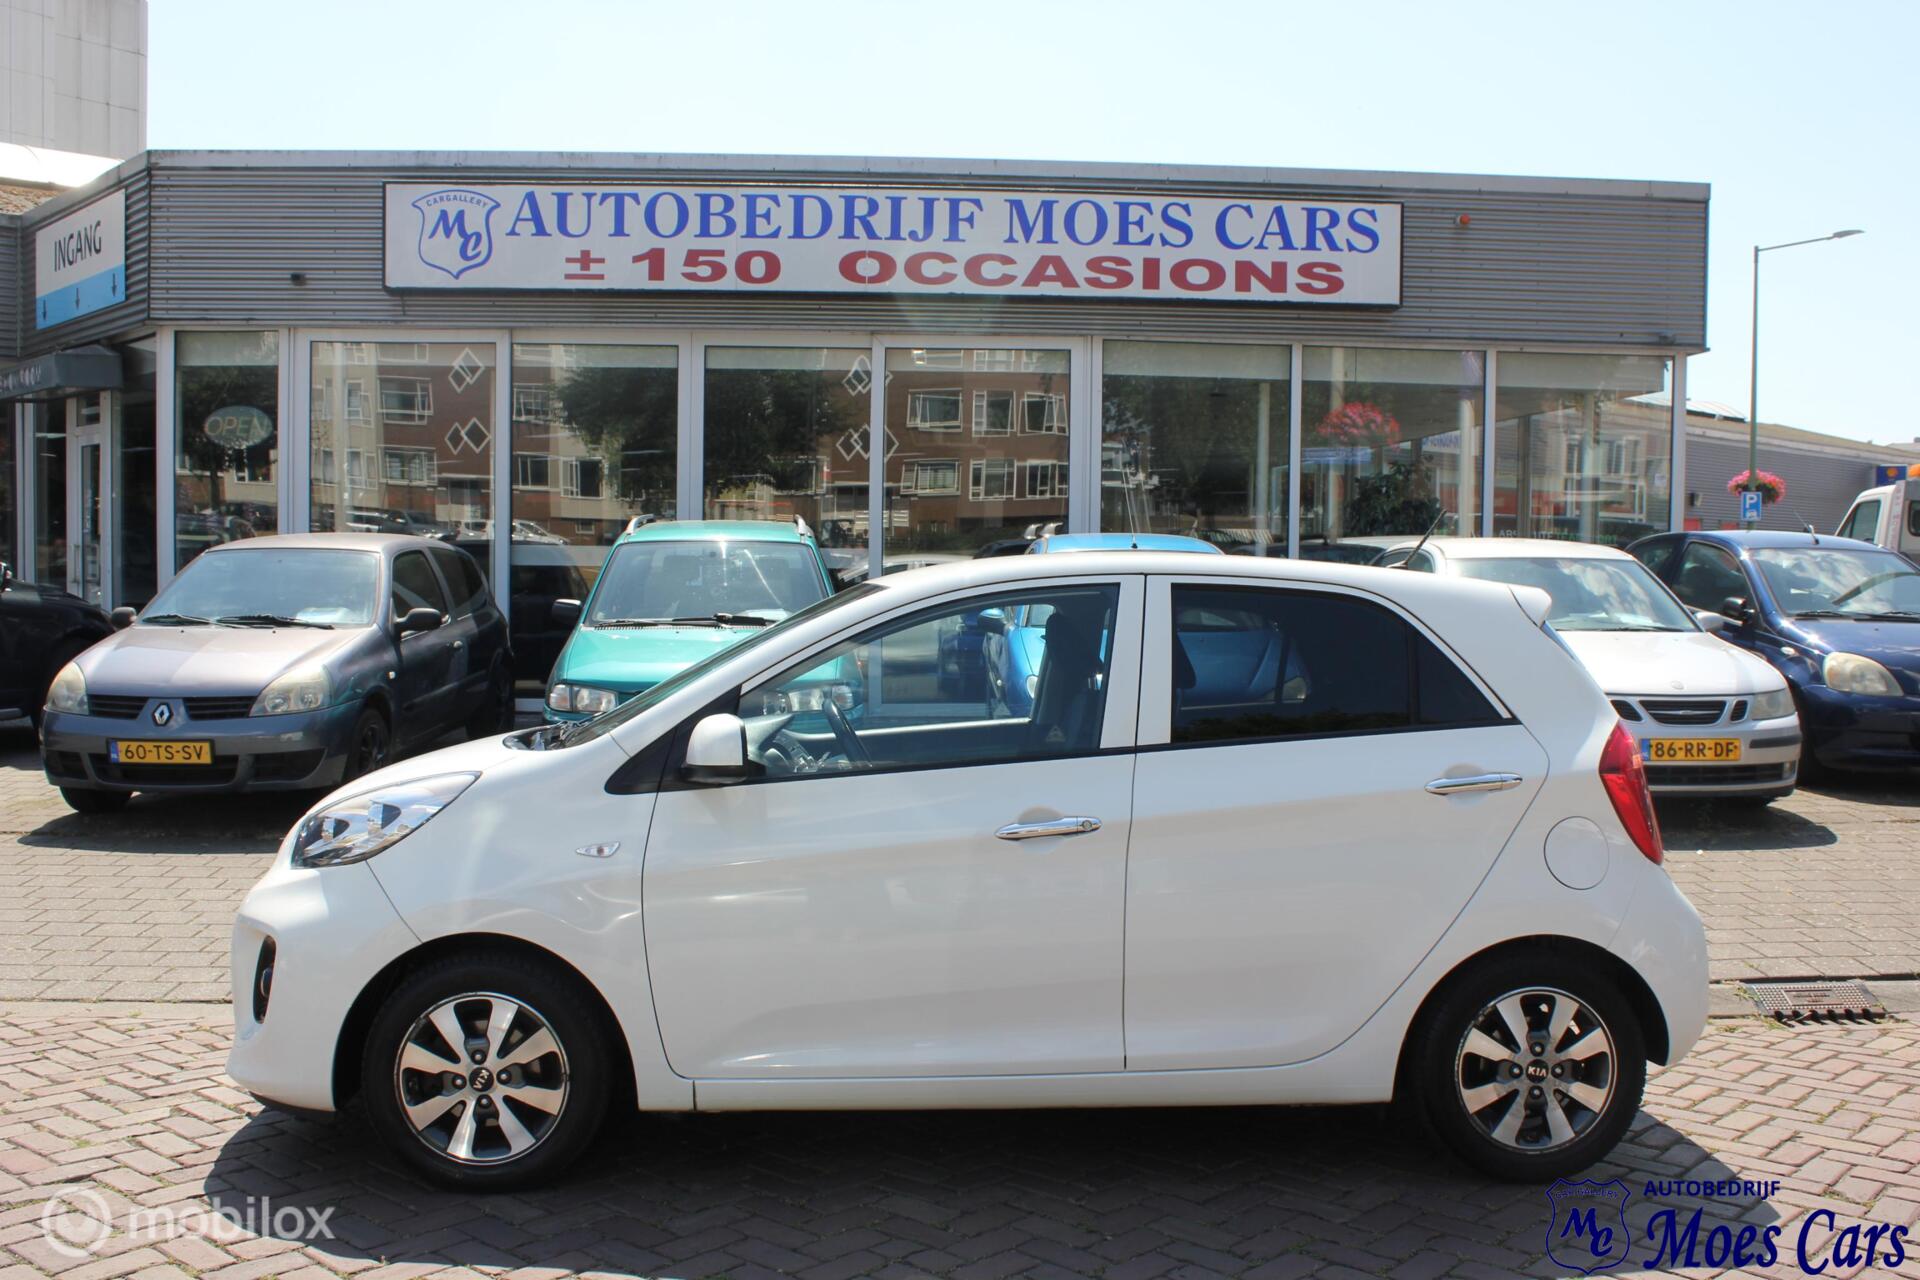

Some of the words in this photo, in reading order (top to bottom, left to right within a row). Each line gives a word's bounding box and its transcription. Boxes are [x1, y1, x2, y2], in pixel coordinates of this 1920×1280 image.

[426, 195, 488, 208] CARGALLERY
[506, 190, 983, 243] AUTOBEDRIJF
[1004, 199, 1194, 249] MOES
[1215, 204, 1381, 254] CARS
[54, 220, 102, 272] INGANG
[632, 247, 782, 284] 150
[839, 250, 1346, 294] OCCASIONS
[204, 416, 268, 440] OPEN
[1746, 495, 1758, 509] P
[125, 744, 203, 760] 60-TS-SV
[1654, 741, 1734, 758] 86-RR-DF
[1528, 1065, 1547, 1077] KIA
